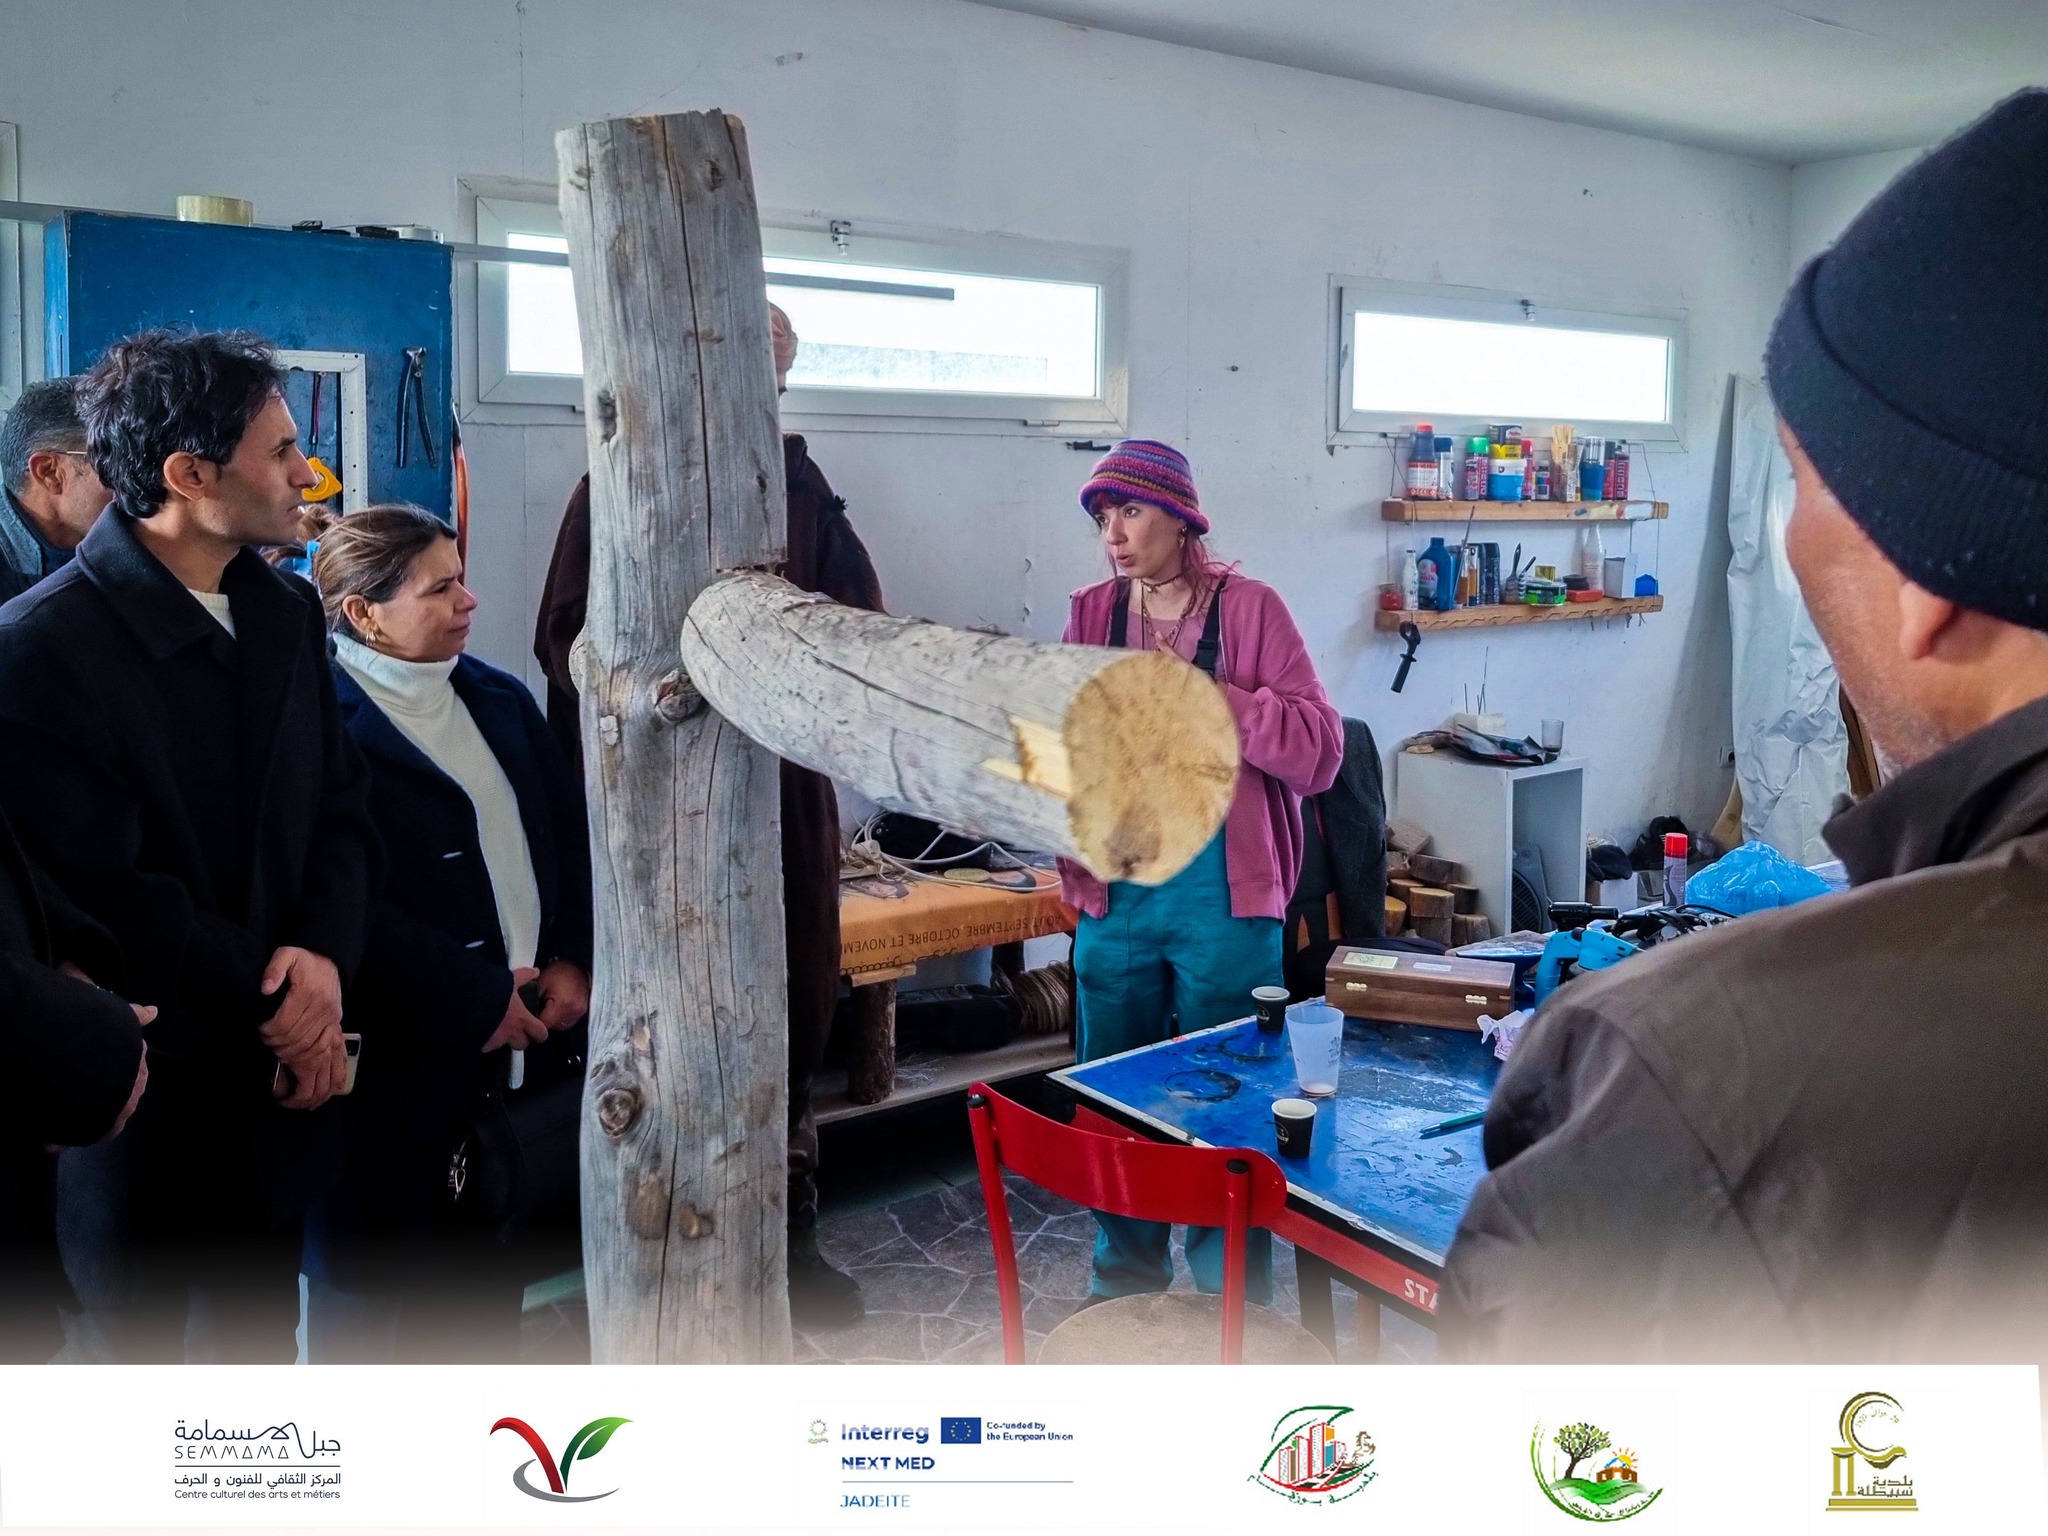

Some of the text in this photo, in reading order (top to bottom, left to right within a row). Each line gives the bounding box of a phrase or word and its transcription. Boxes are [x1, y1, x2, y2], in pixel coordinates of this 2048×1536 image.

[890, 935, 904, 947] ET
[909, 928, 960, 945] OCTOBRE
[841, 938, 886, 953] NOVEM
